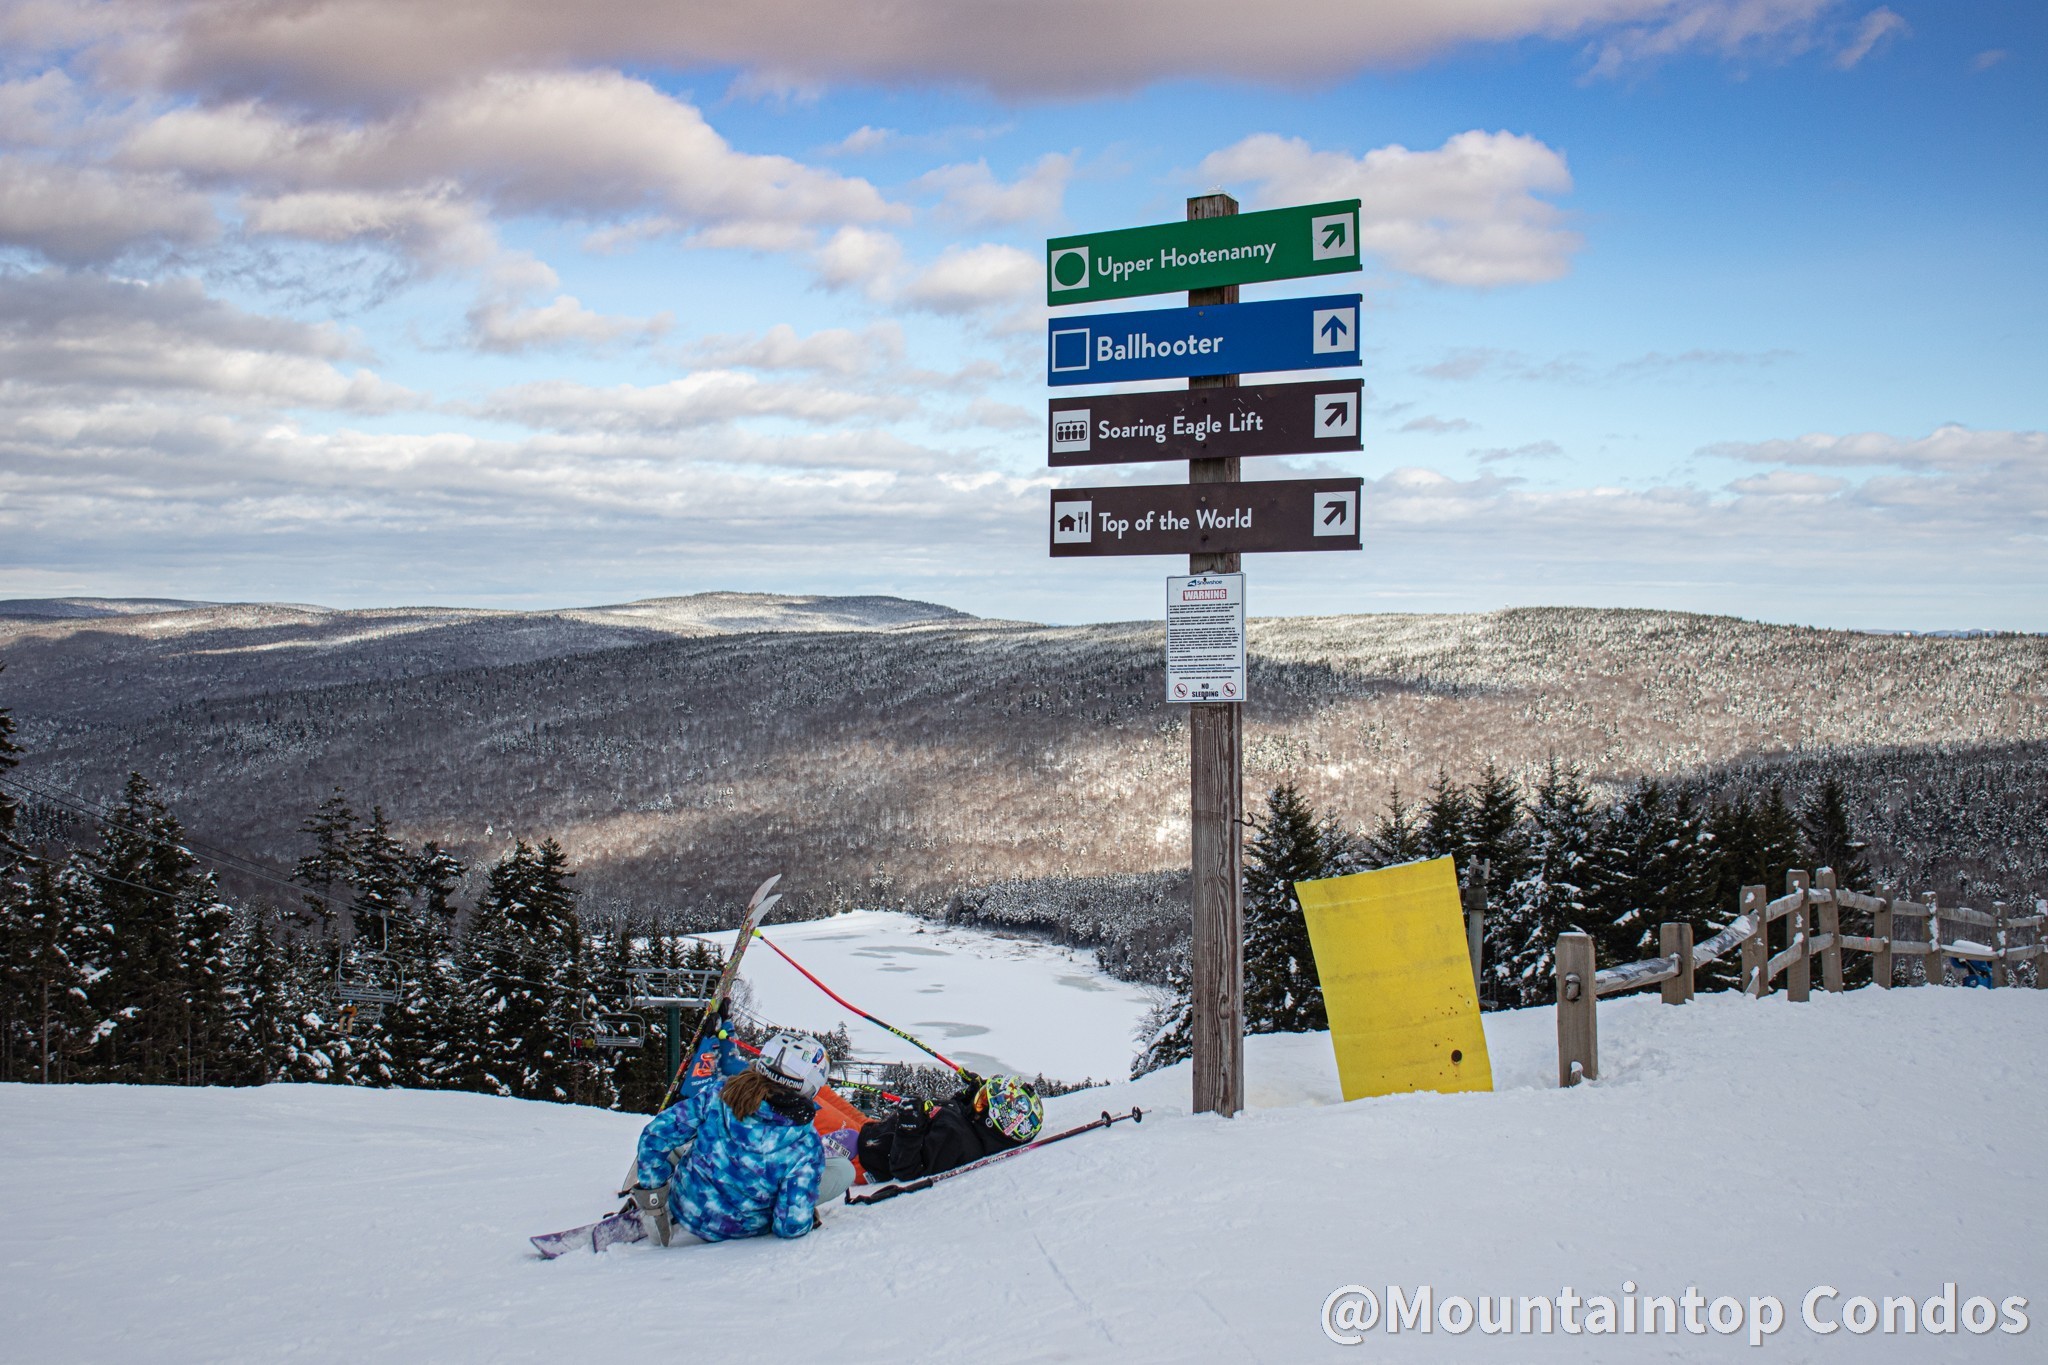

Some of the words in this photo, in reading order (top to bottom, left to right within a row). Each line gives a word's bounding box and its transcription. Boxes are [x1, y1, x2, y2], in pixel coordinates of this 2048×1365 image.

[1097, 256, 1154, 282] Upper
[1160, 242, 1277, 269] Hootenanny
[1097, 333, 1224, 362] Ballhooter
[1098, 418, 1166, 444] Soaring
[1173, 414, 1222, 442] Eagle
[1229, 411, 1264, 433] Lift
[1098, 512, 1129, 540] Top
[1135, 510, 1155, 531] of
[1159, 510, 1190, 531] the
[1196, 507, 1252, 530] World
[1184, 589, 1226, 600] WARNING
